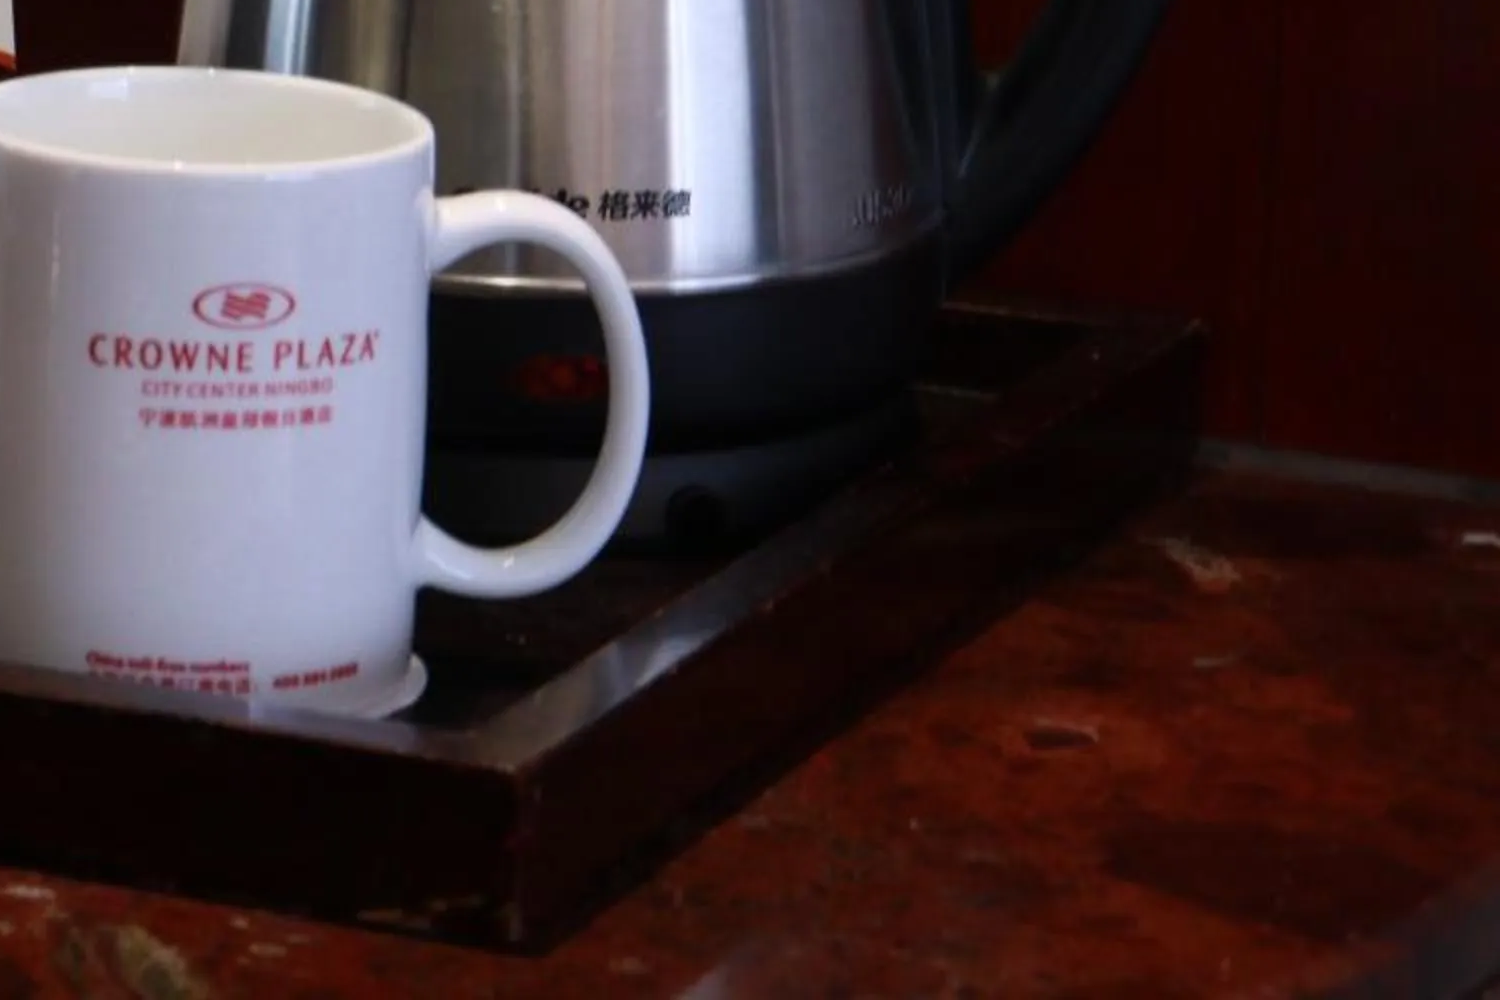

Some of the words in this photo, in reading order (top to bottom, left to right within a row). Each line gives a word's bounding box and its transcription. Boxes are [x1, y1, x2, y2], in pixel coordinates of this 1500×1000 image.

[87, 332, 254, 374] CROWNE
[272, 330, 377, 372] PLAZA
[140, 379, 183, 399] CITY
[186, 379, 259, 400] CENTER
